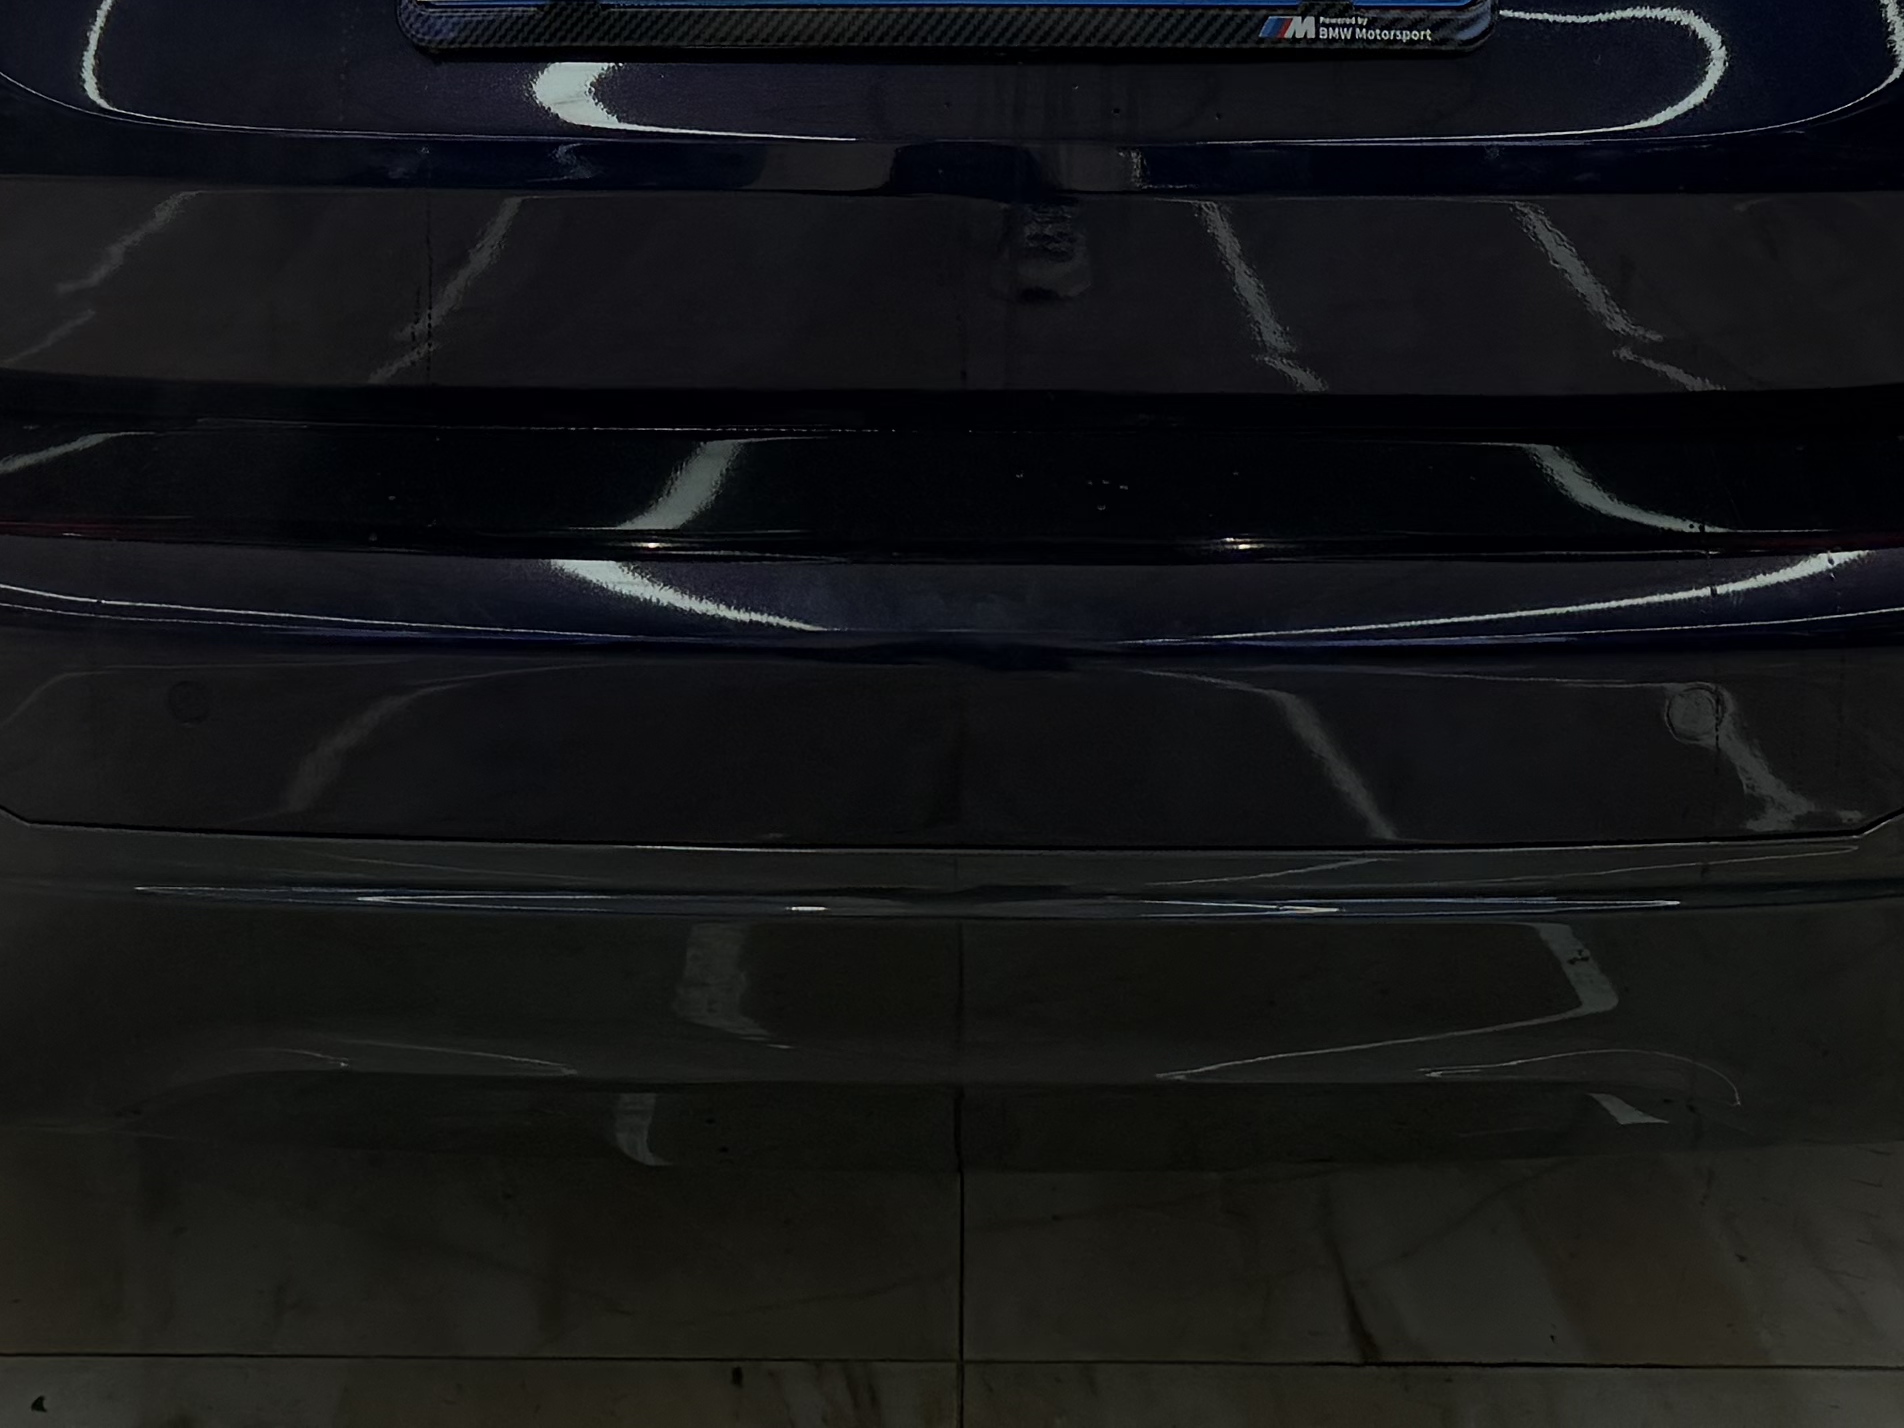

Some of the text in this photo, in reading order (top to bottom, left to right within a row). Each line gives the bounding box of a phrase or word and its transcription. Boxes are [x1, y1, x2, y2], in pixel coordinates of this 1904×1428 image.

[1319, 16, 1368, 26] Powered by
[1319, 26, 1432, 43] BMW Motorsport
